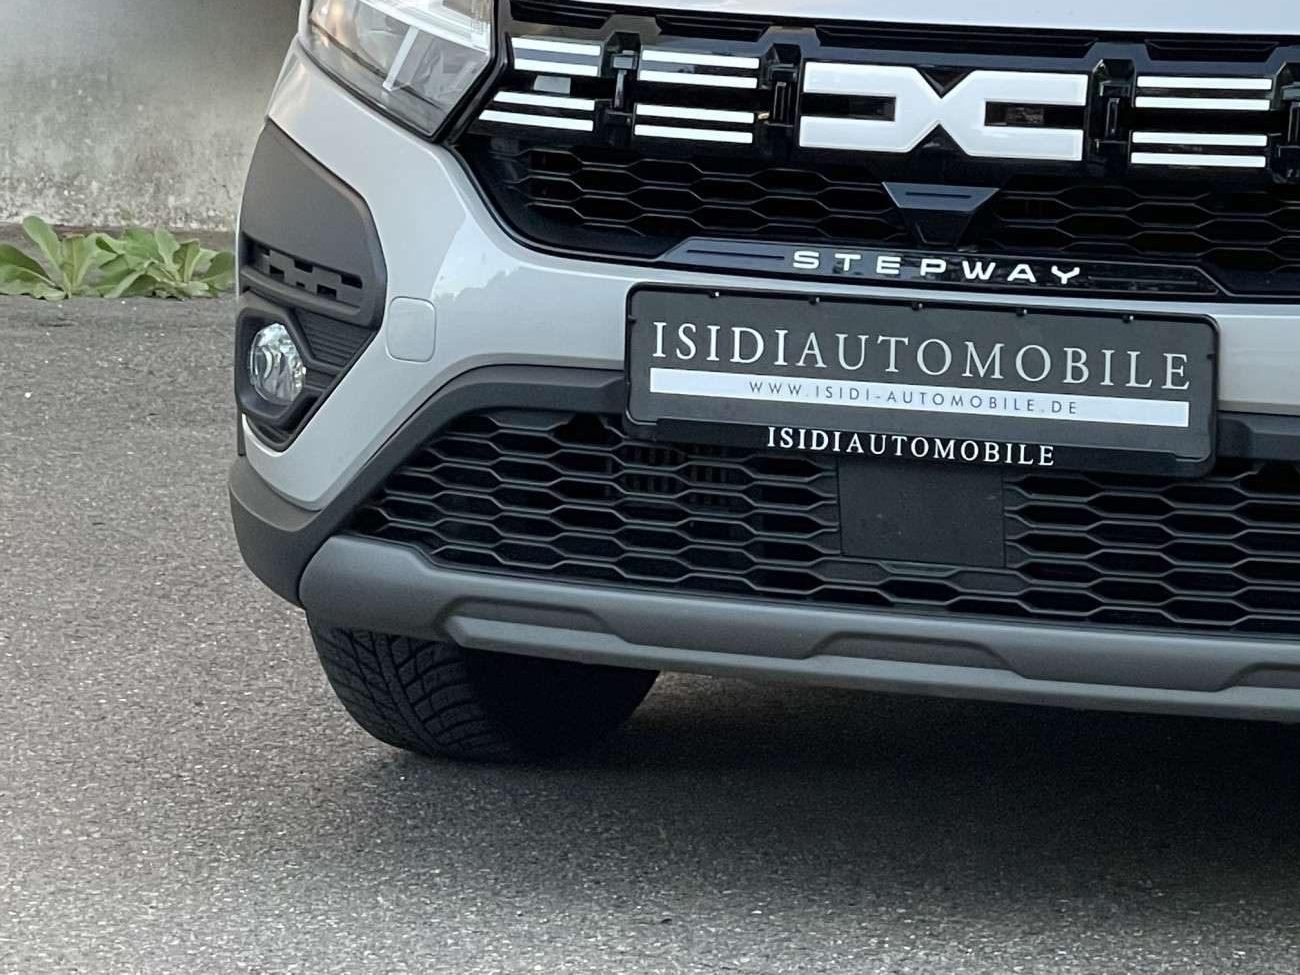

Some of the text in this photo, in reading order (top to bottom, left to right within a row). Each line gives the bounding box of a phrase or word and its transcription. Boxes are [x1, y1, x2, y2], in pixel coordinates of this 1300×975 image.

[793, 250, 1081, 284] STEPWAY
[652, 322, 1190, 390] ISIDIAUTOMOBILE
[749, 380, 1077, 414] WWW.ISIDI-AUTOMOBILE.DE
[767, 427, 1055, 466] ISIDIAUTOMOBILE
